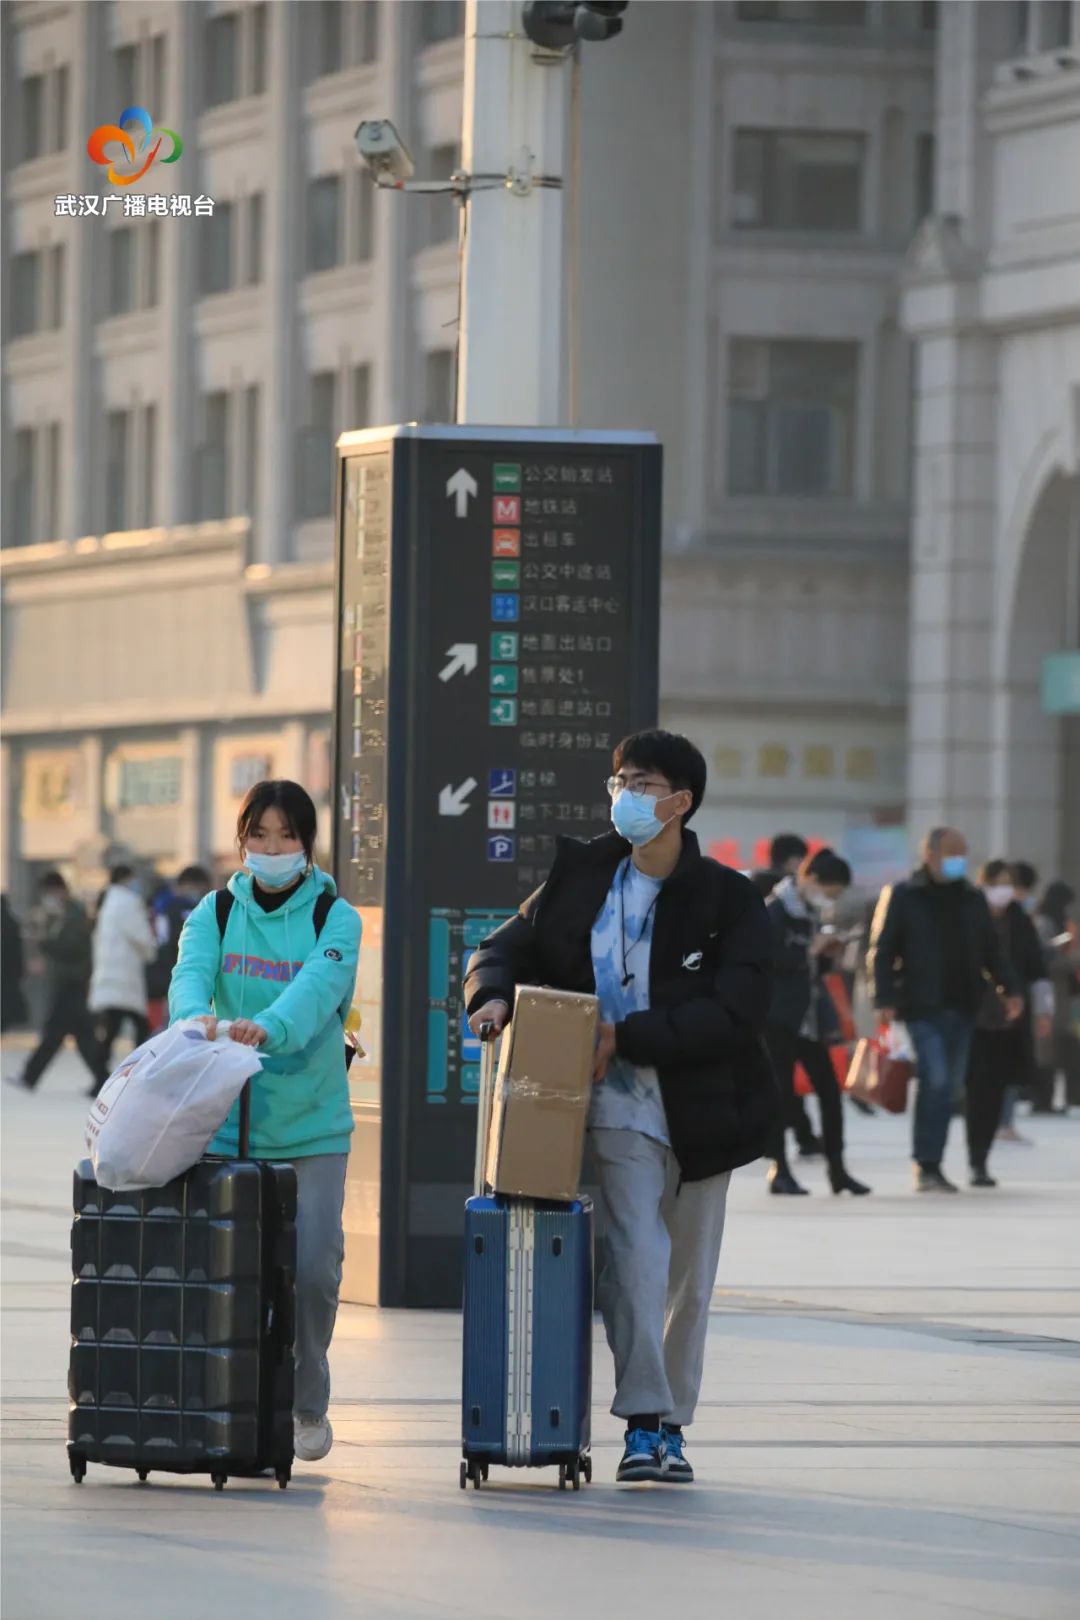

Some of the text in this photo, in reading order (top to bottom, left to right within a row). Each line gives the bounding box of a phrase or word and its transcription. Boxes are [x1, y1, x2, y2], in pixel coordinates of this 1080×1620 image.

[524, 498, 577, 515] 地铁站
[523, 531, 576, 547] 出租车
[519, 731, 611, 750] 临时身份证
[495, 841, 509, 857] P
